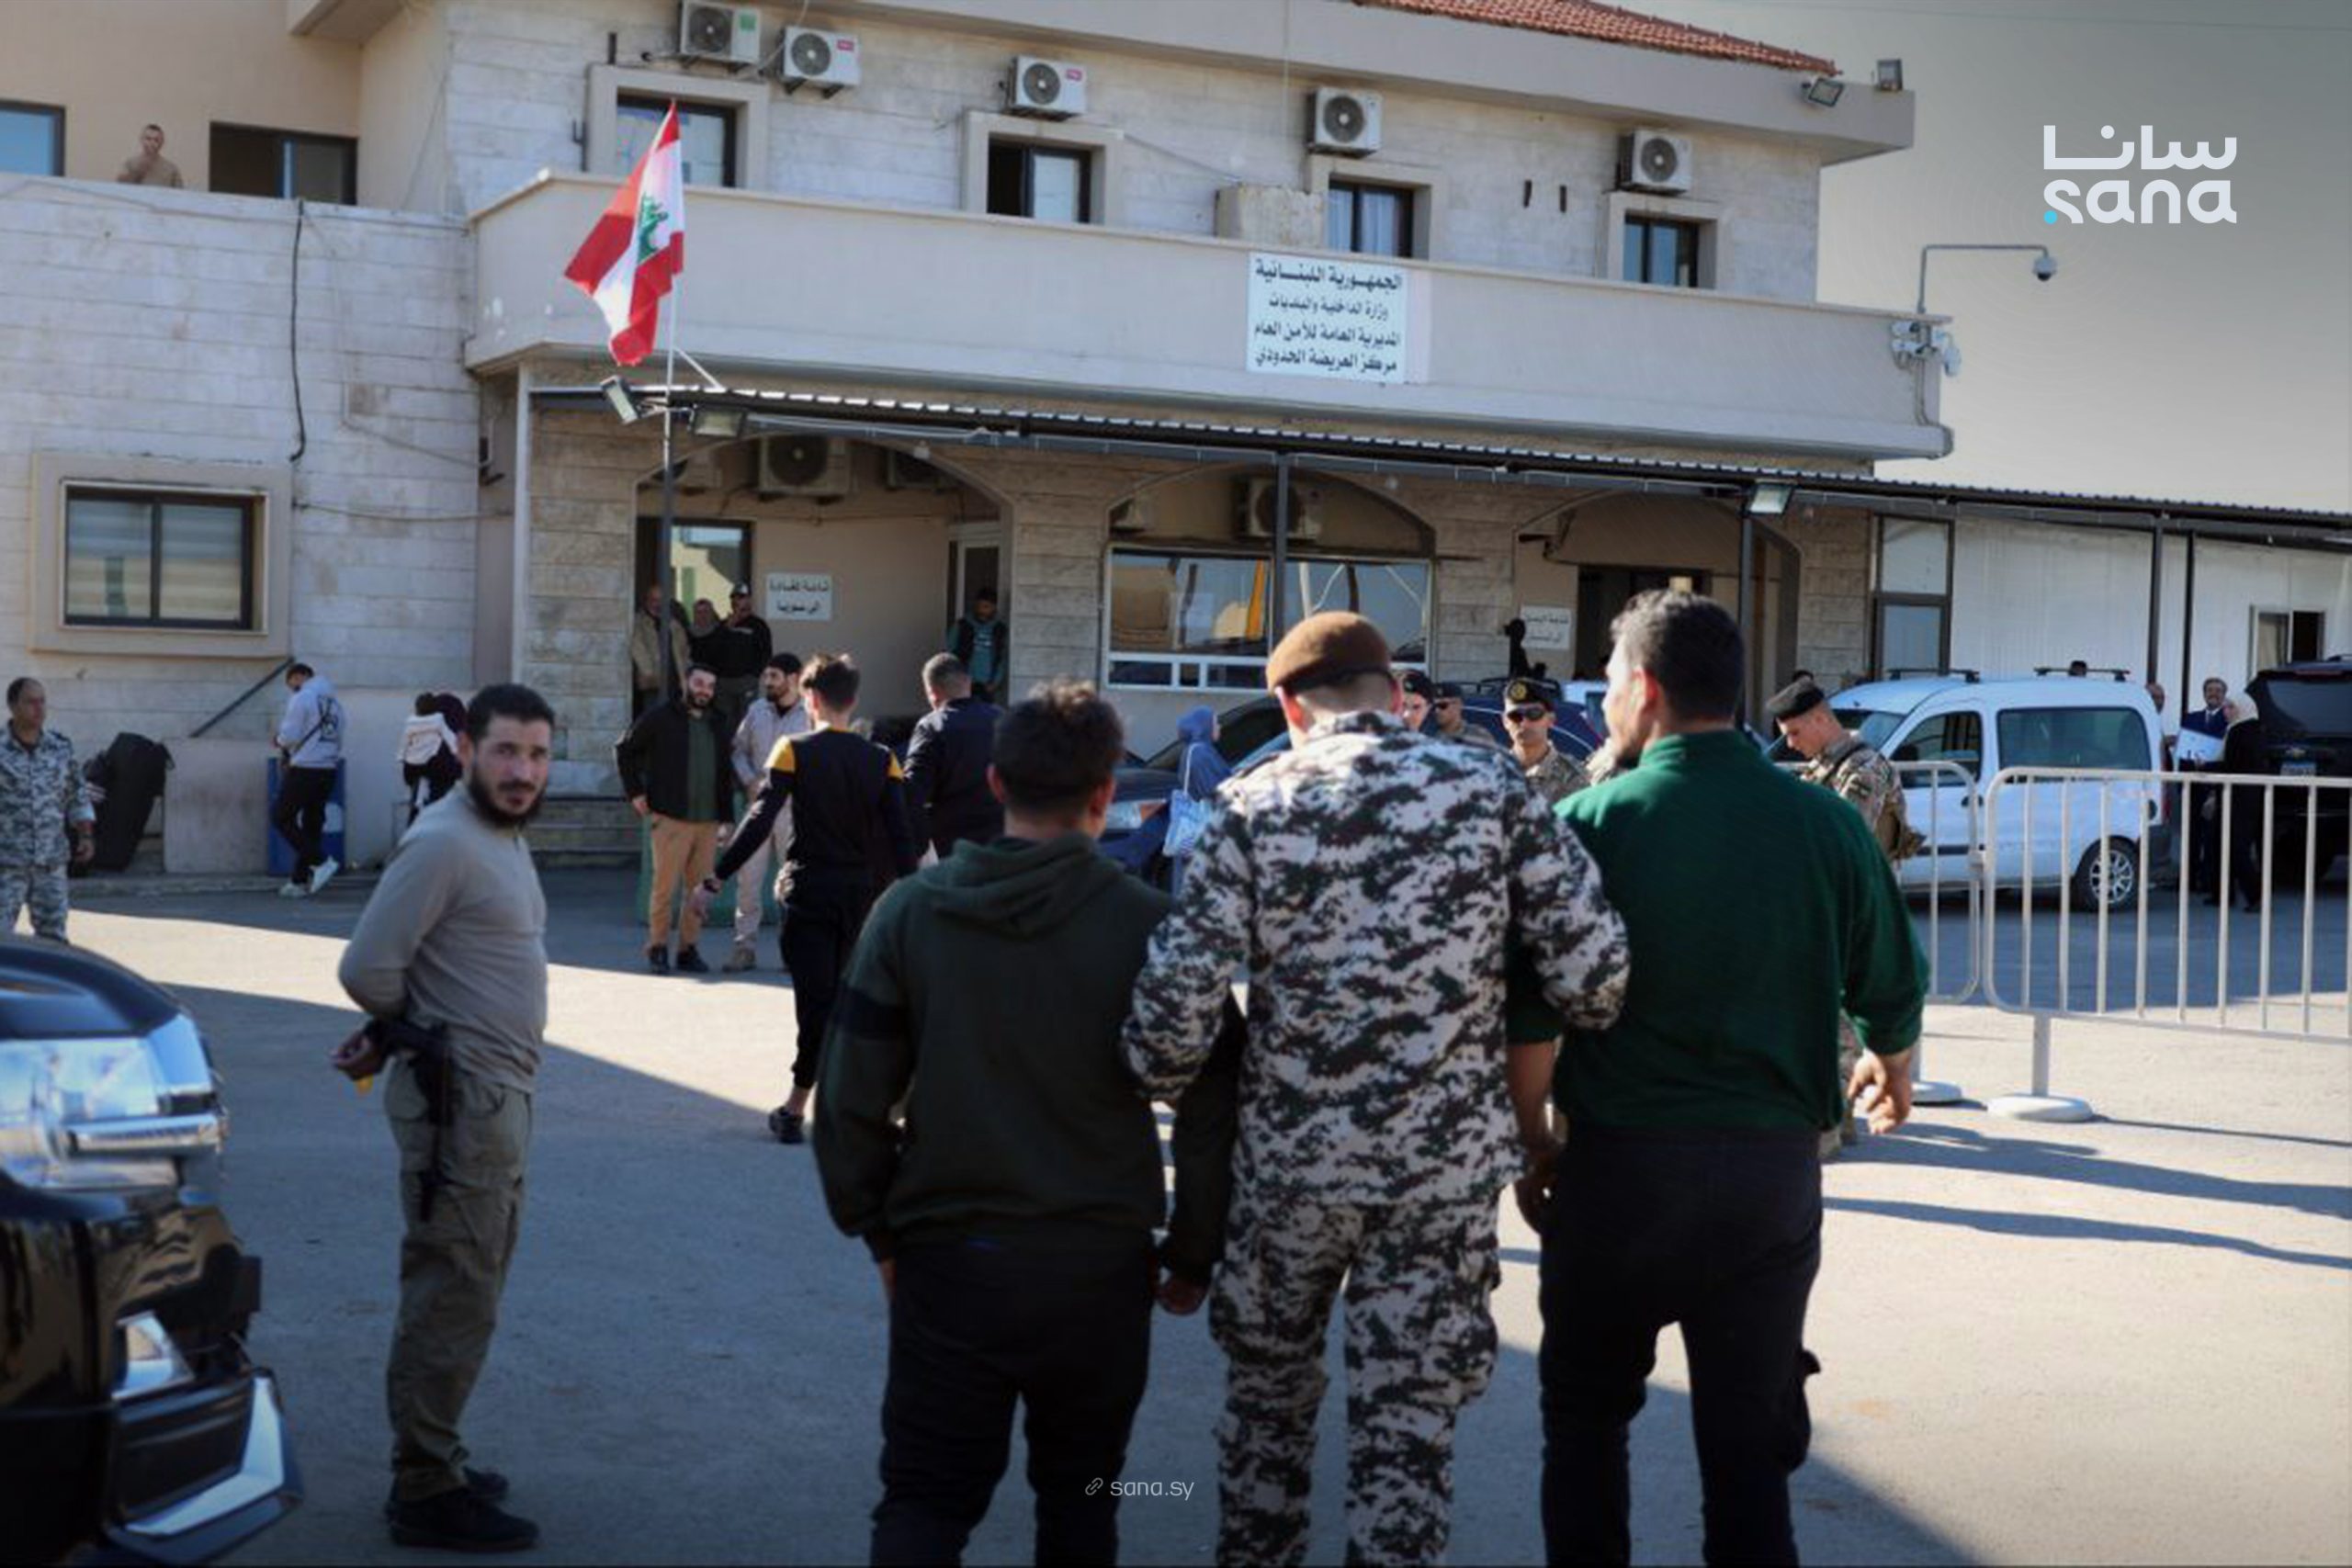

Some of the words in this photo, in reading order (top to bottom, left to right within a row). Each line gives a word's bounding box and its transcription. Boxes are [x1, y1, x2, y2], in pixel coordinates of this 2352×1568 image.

[1365, 299, 1388, 321] وزارة
[1253, 321, 1282, 340] العام
[1320, 321, 1356, 342] العامة
[1358, 326, 1400, 350] المديرية
[1308, 347, 1358, 371] العريضة
[1360, 353, 1396, 376] مركز
